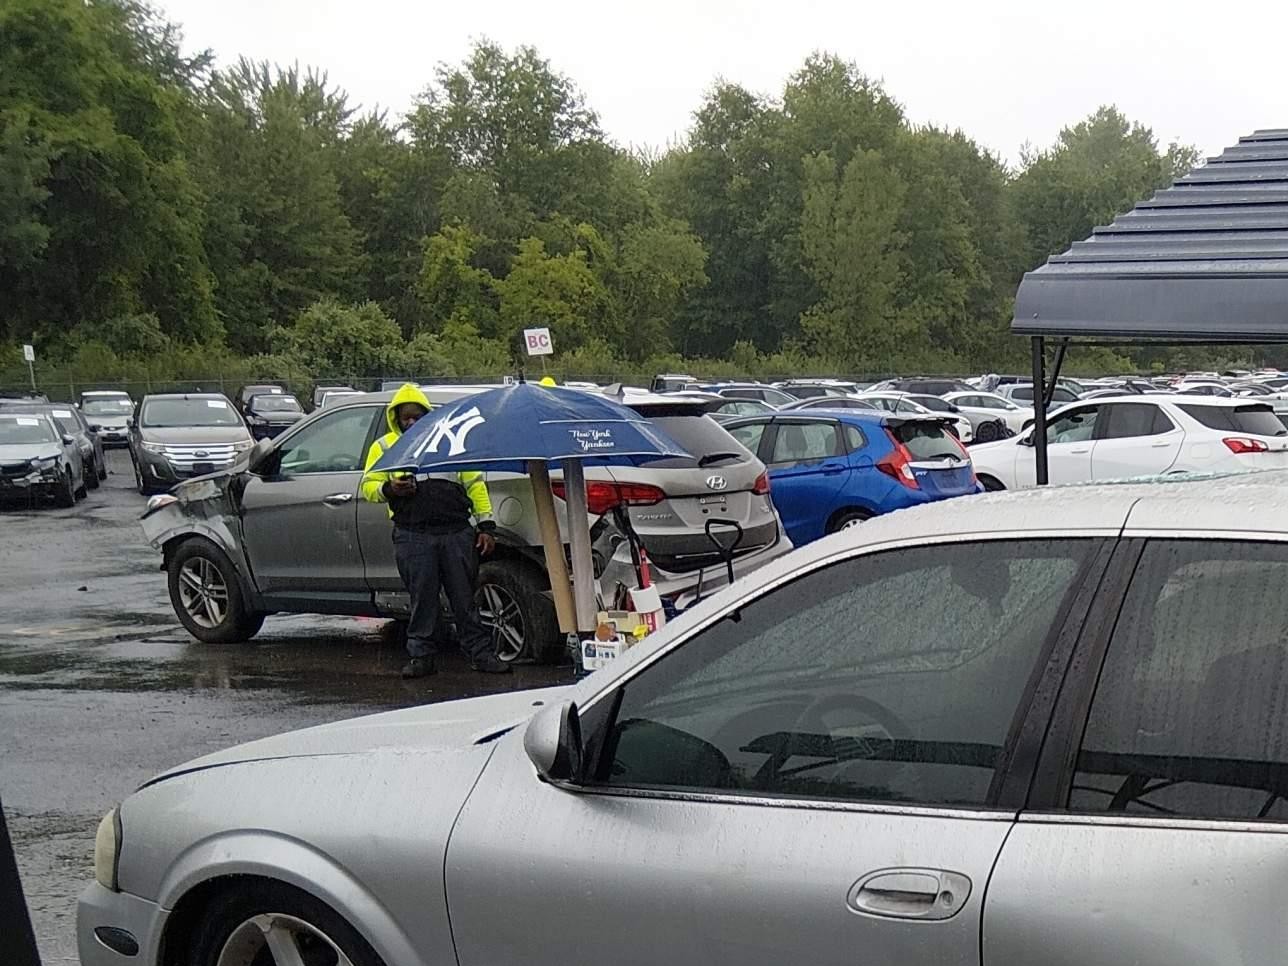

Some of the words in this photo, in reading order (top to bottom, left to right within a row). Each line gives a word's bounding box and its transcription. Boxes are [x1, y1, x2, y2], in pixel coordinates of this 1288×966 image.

[527, 334, 549, 349] BC
[568, 429, 590, 438] New
[588, 429, 611, 440] York
[576, 438, 615, 451] Yankees
